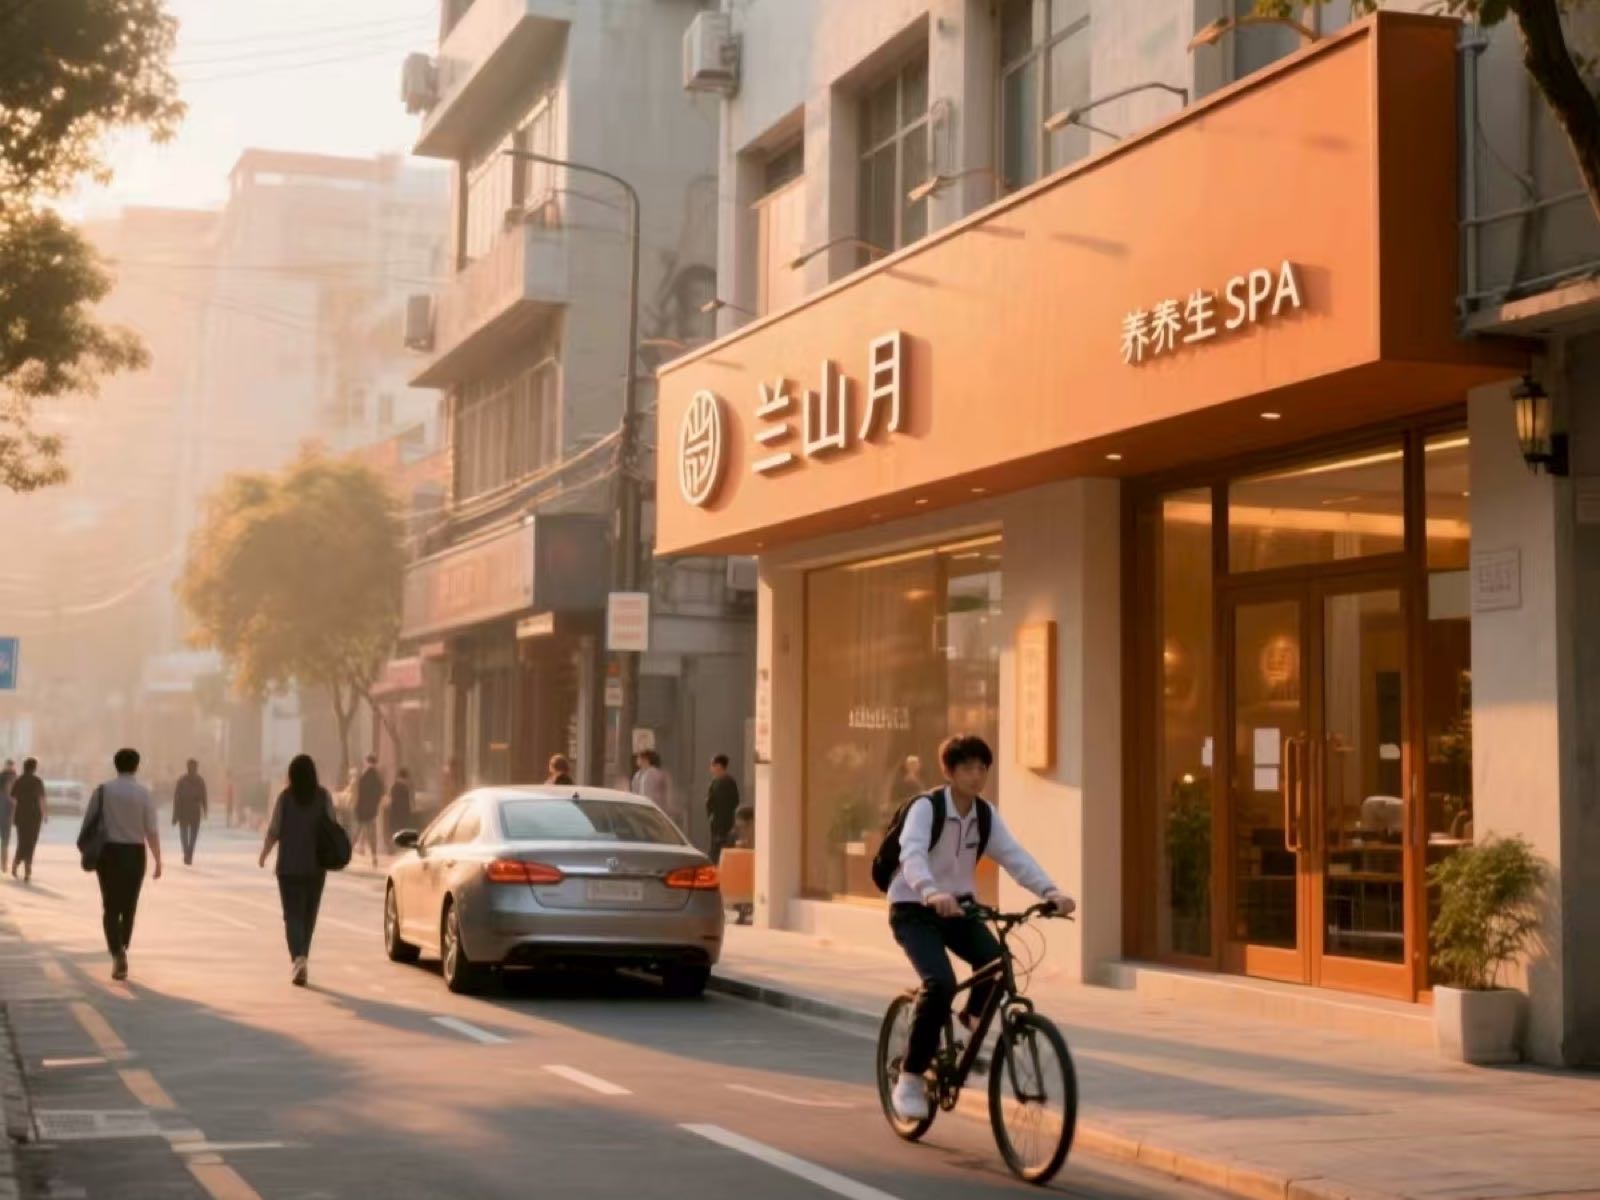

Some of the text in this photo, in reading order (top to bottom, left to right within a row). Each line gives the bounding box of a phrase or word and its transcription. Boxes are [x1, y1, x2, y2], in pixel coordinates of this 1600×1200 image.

[1225, 259, 1300, 329] SPA
[752, 330, 900, 473] 兰山月
